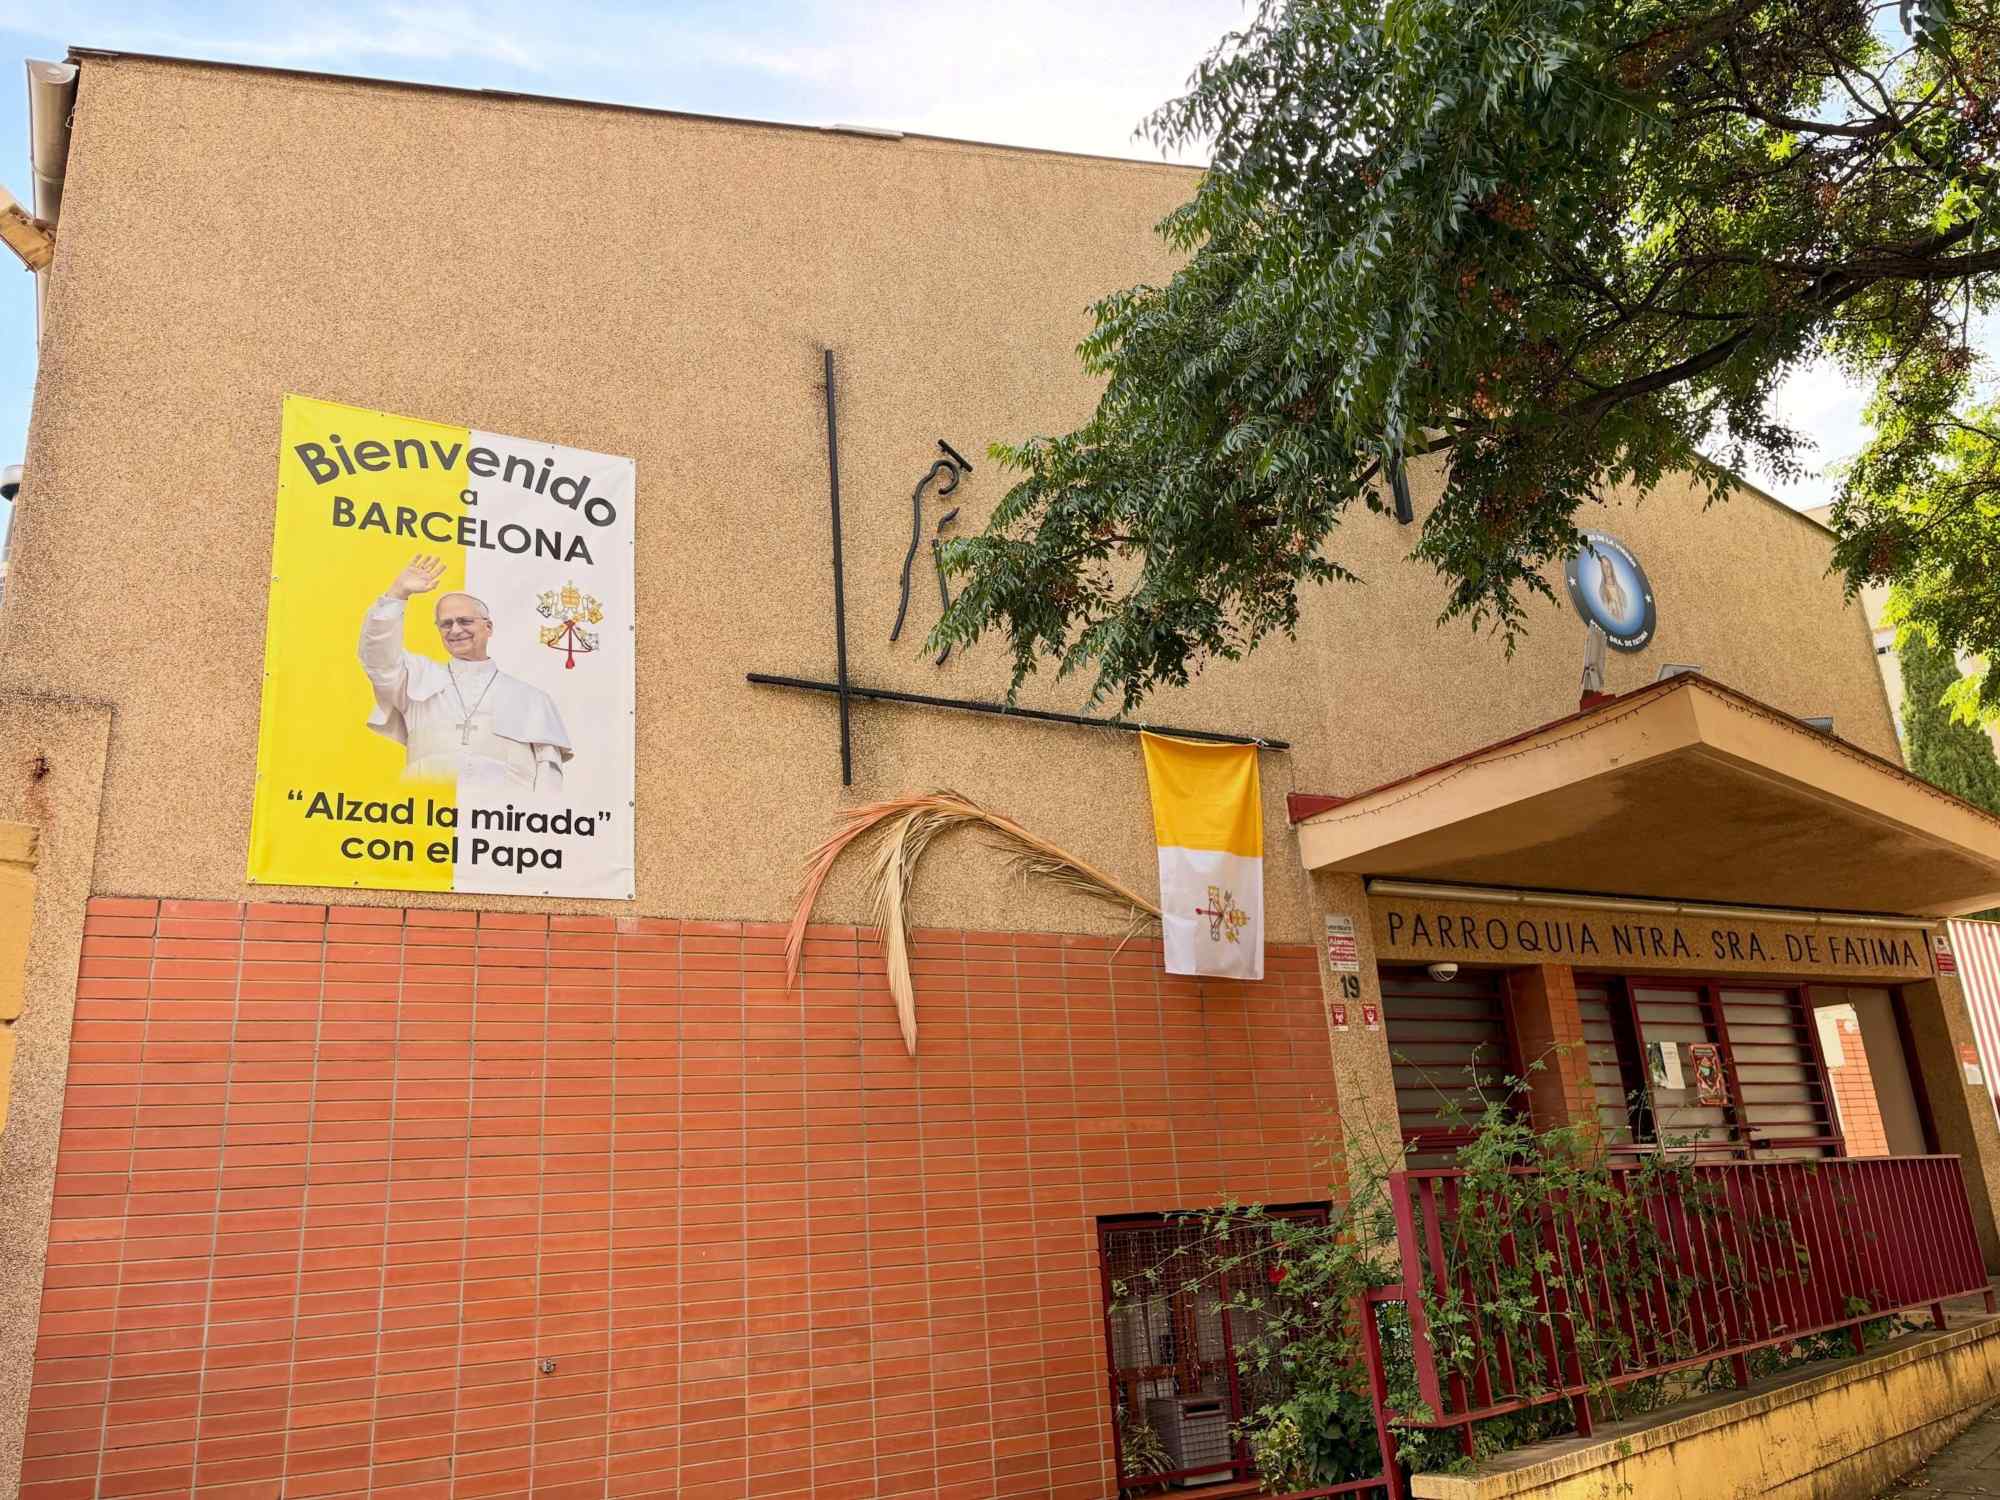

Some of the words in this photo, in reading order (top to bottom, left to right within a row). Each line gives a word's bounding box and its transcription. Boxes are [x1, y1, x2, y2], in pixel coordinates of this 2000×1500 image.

[295, 433, 617, 528] Bienvenido
[460, 486, 479, 507] a
[332, 496, 594, 565] BARCELONA
[426, 798, 459, 829] la
[340, 838, 414, 862] con
[426, 836, 459, 864] el
[471, 838, 563, 873] Papa
[1387, 911, 1600, 954] PARROQUIA
[1612, 924, 1701, 960] NTRA.
[1711, 929, 1776, 962] SRA.
[1785, 933, 1821, 964] DE
[1828, 935, 1919, 968] FATIMA
[1340, 974, 1361, 999] 19
